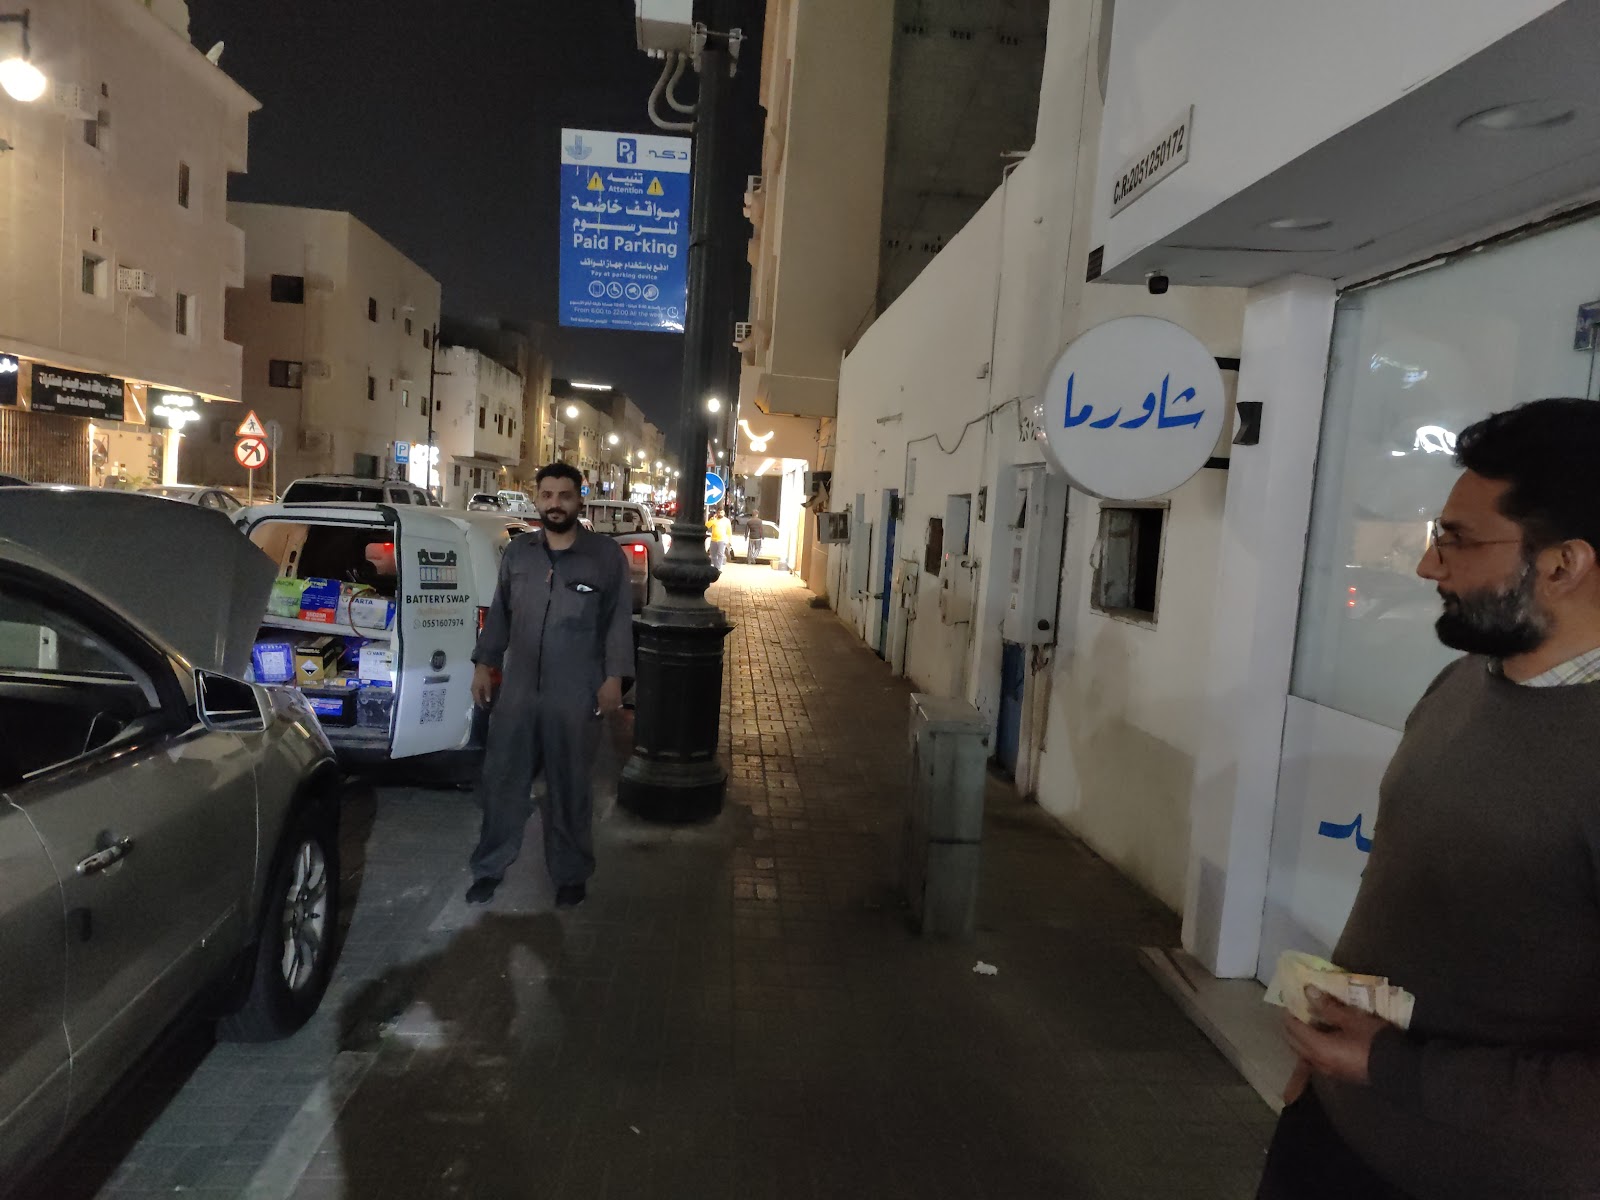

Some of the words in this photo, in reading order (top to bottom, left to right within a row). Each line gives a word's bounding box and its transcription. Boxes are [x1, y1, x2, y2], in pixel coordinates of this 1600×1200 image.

[606, 172, 644, 186] تنبيه
[608, 185, 644, 194] Attention
[571, 195, 622, 213] خاضعة
[625, 200, 680, 220] مواقف
[572, 218, 679, 236] للرسوم
[573, 233, 609, 249] Paid
[614, 236, 678, 258] Parking
[591, 270, 602, 278] Pay
[612, 272, 636, 280] parking
[1063, 371, 1206, 430] شاورما
[422, 618, 464, 628] 0551607974
